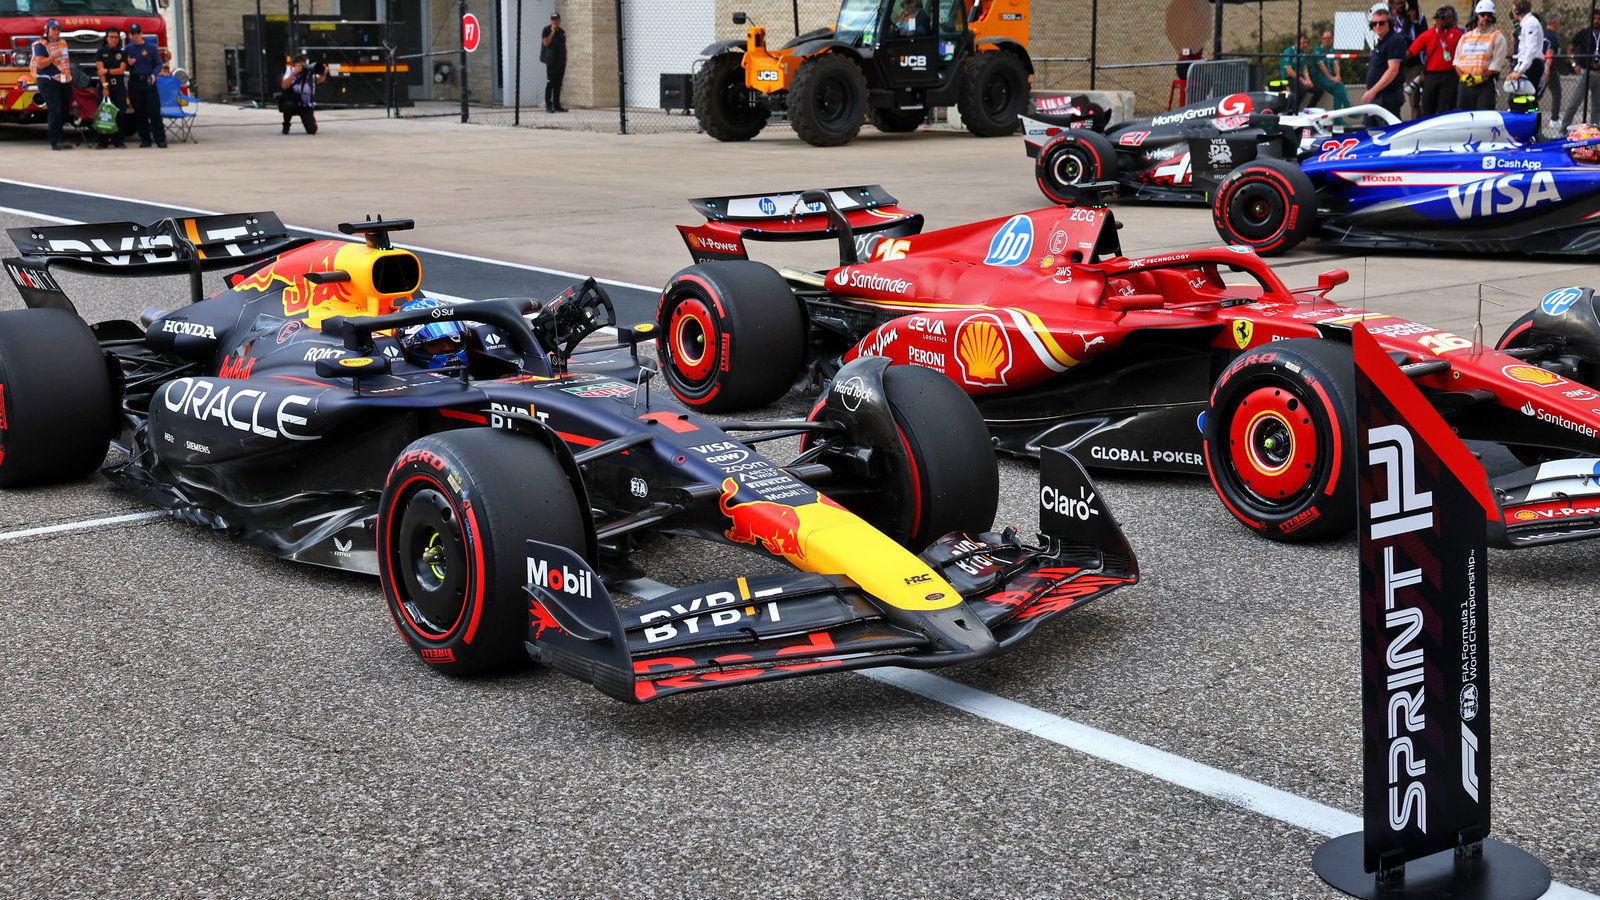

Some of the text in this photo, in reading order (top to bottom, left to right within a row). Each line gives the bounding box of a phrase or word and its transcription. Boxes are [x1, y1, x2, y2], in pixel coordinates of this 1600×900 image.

[65, 18, 102, 26] AUSTIN
[464, 23, 474, 41] P7
[900, 55, 927, 67] JCB
[756, 70, 779, 82] JCB
[1151, 105, 1216, 127] MoneyGram
[1119, 131, 1151, 146] 27
[1319, 139, 1360, 162] 22
[1497, 159, 1542, 170] Cash App
[1448, 170, 1562, 220] VISA
[759, 197, 776, 216] hp
[1069, 208, 1096, 222] ZCG
[697, 236, 738, 252] V-Power
[988, 216, 1032, 265] hp
[1147, 254, 1190, 264] TECHNOLOGY
[7, 264, 48, 291] Mobil
[850, 270, 913, 294] Santander
[1543, 288, 1580, 314] hp
[162, 319, 217, 340] HONDA
[922, 334, 948, 343] LOGISTICS
[303, 347, 347, 361] ROKT
[1416, 332, 1473, 356] 16
[908, 345, 946, 367] PERONI
[1220, 352, 1279, 388] ZERO
[834, 380, 874, 403] Hard Rock
[164, 377, 323, 441] ORACLE
[1536, 408, 1599, 438] Santander
[186, 440, 211, 455] SIEMENS
[688, 441, 739, 454] VISA
[706, 452, 741, 464] CDW
[1091, 446, 1203, 466] GLOBAL POKER
[396, 448, 448, 471] ZERO
[720, 461, 769, 474] zoom
[630, 478, 649, 497] FIA
[755, 483, 803, 495] Infinitum
[764, 489, 799, 501] Mobil
[1040, 486, 1092, 521] Claro
[1278, 505, 1321, 534] PIRELLI
[526, 557, 592, 599] Mobil
[904, 573, 932, 585] HRC
[640, 577, 784, 643] BYBIT
[1460, 608, 1469, 661] Formula
[420, 647, 456, 664] PIRELLI
[1469, 645, 1477, 681] World
[1461, 662, 1470, 683] FIA
[1383, 545, 1427, 835] SPRINT
[1460, 682, 1479, 721] FIA
[1461, 721, 1479, 804] F1
